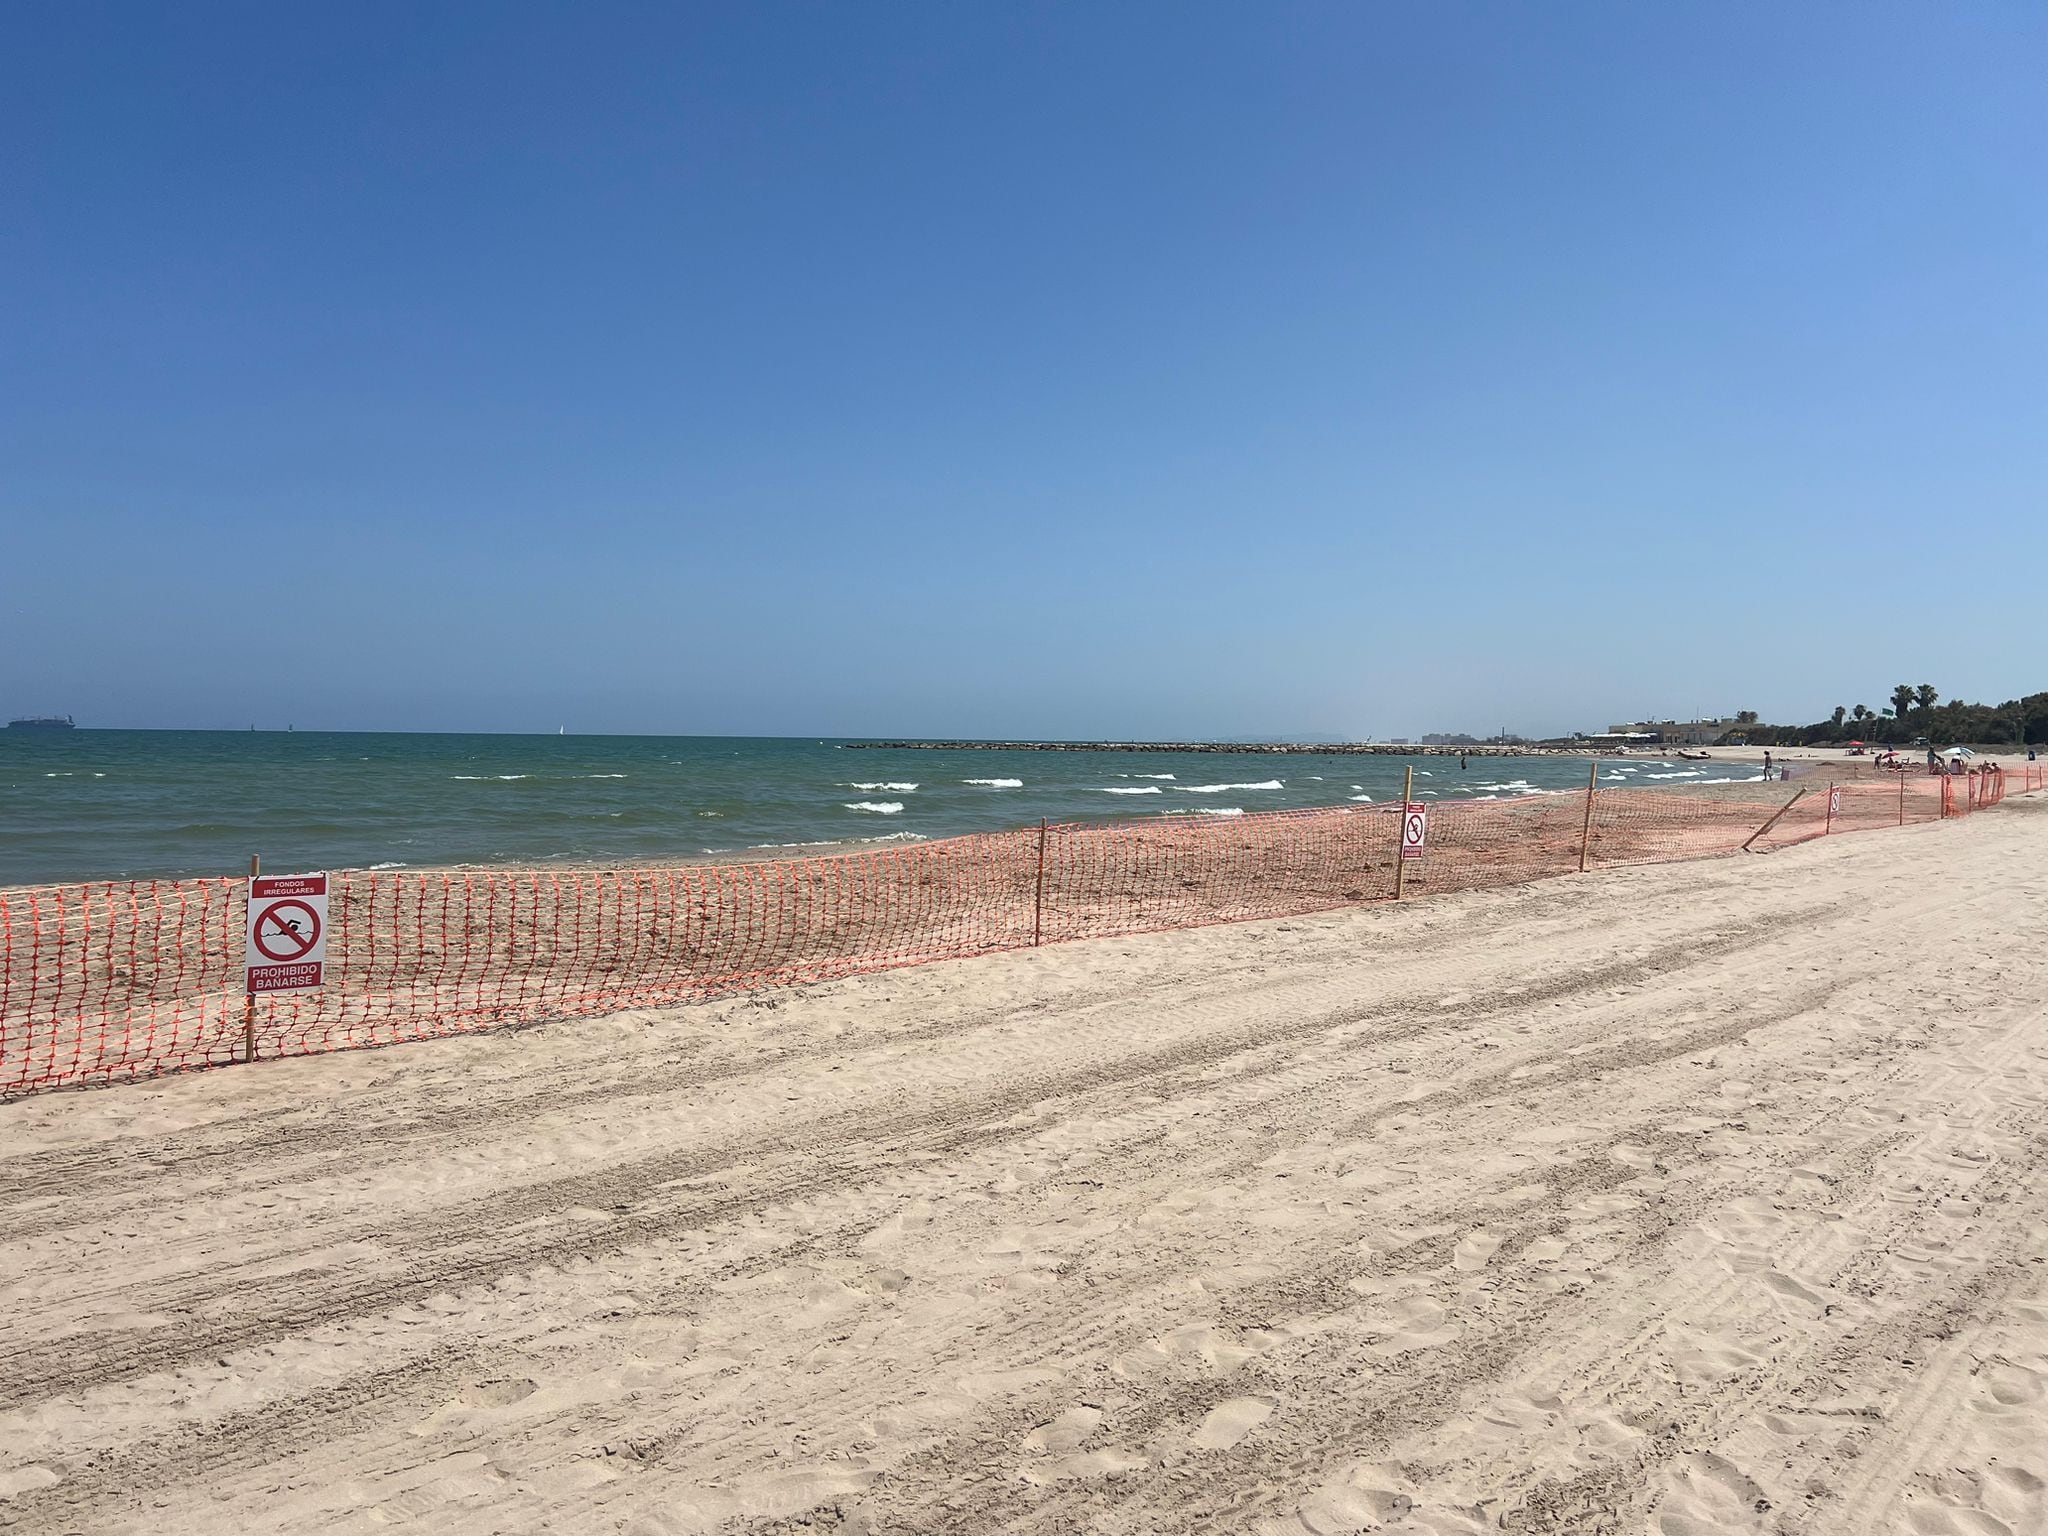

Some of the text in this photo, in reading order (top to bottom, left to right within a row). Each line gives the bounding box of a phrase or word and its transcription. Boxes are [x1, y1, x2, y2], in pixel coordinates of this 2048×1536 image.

[274, 880, 305, 888] FONDOS
[263, 887, 315, 896] IRREGULARES
[252, 964, 318, 979] PROHIBIDO
